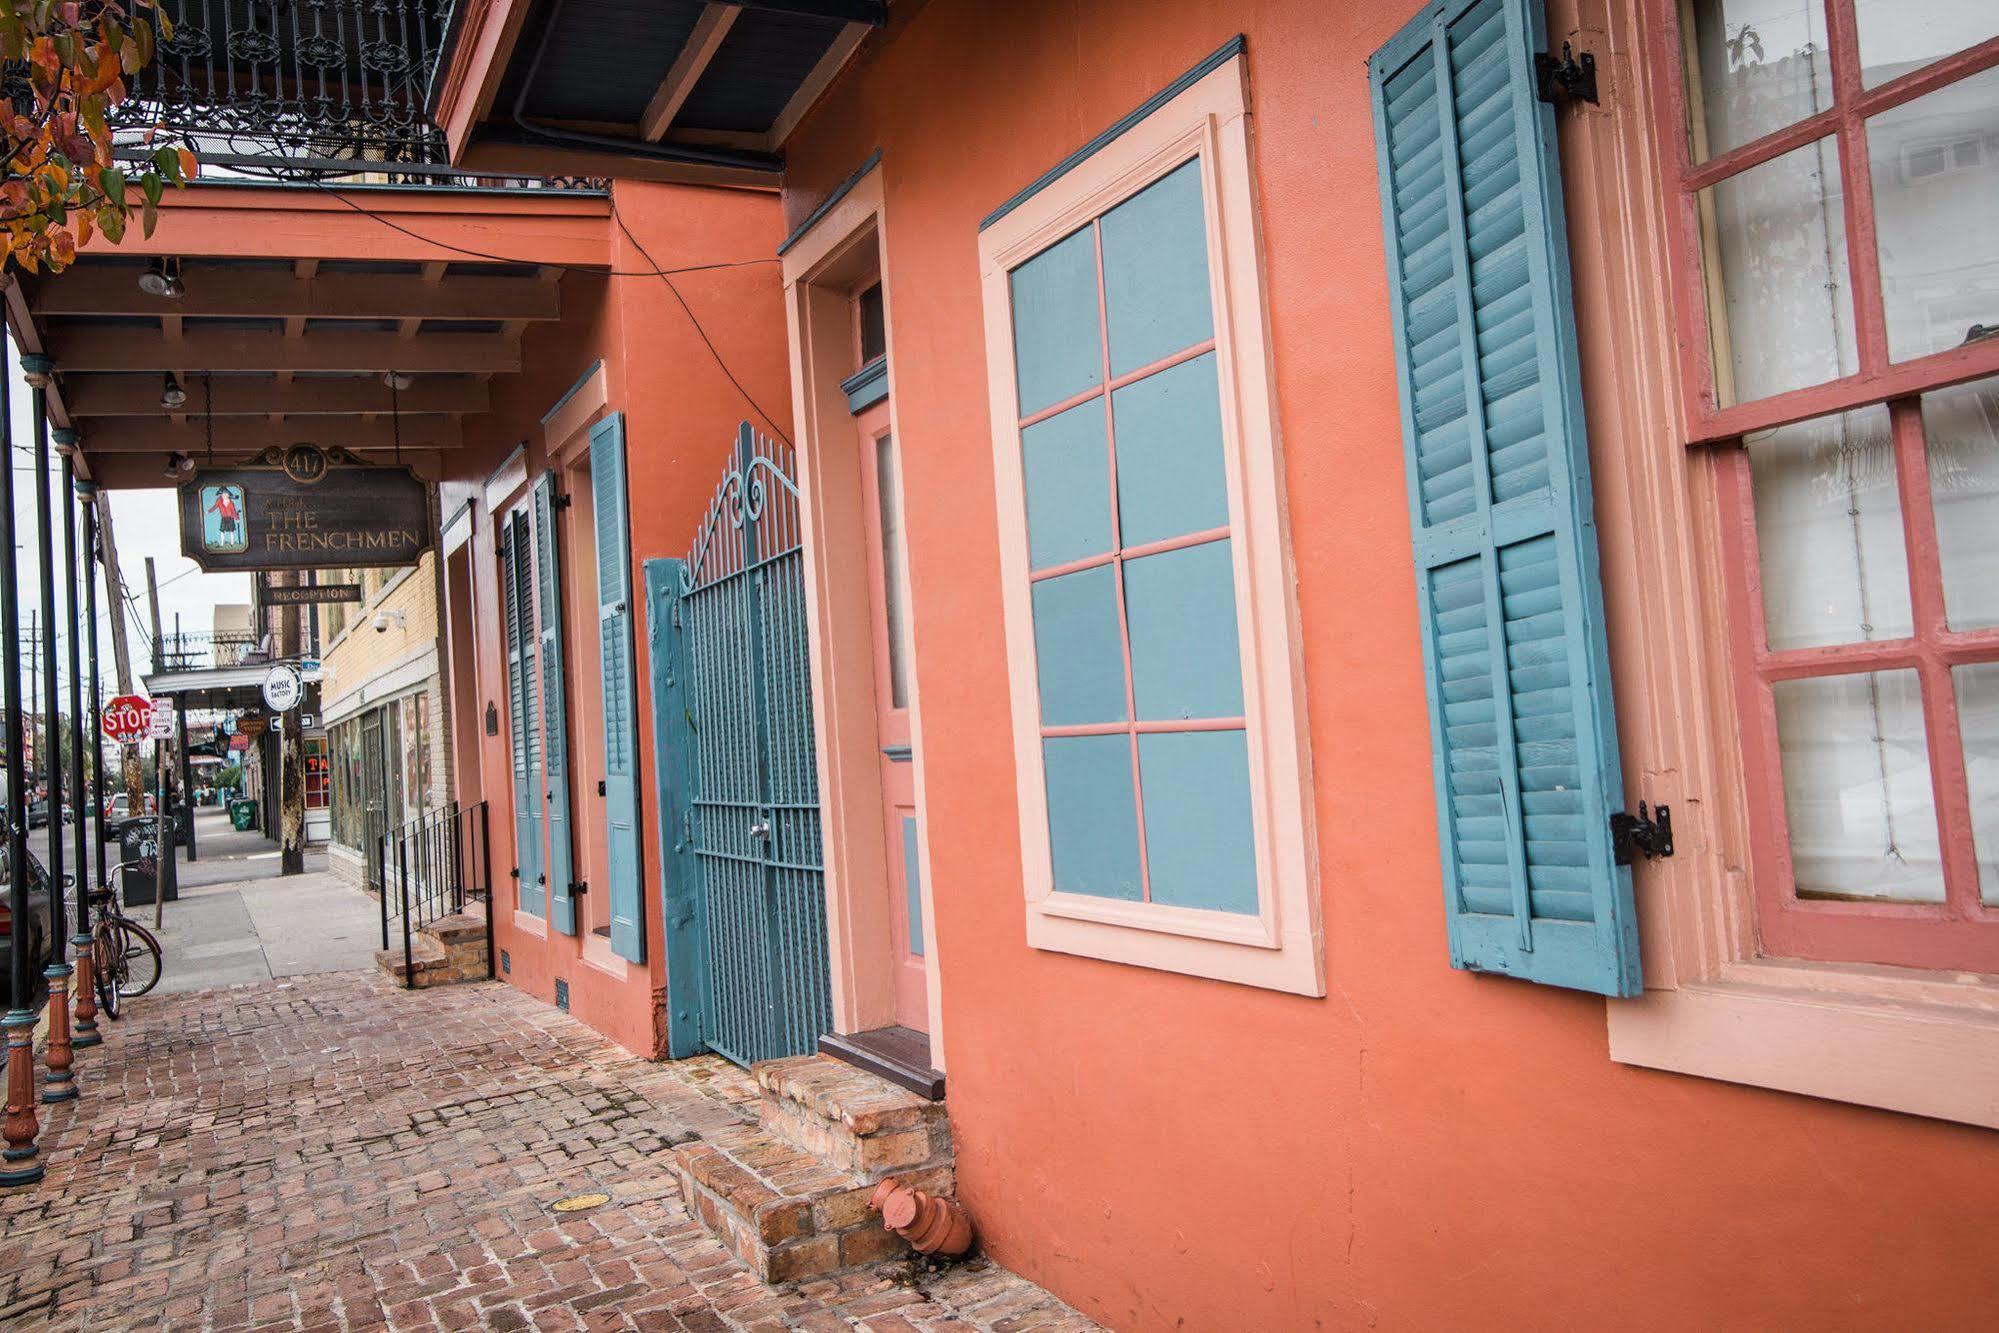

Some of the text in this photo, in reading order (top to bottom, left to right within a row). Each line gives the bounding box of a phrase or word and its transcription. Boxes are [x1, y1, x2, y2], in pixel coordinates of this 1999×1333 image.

[291, 454, 320, 473] 417
[263, 511, 319, 529] THE
[265, 531, 419, 551] FRENCHMEN
[273, 588, 350, 600] RECEPTION
[271, 680, 290, 691] MUSIC
[271, 689, 291, 698] FACTORY
[105, 708, 151, 731] STOP
